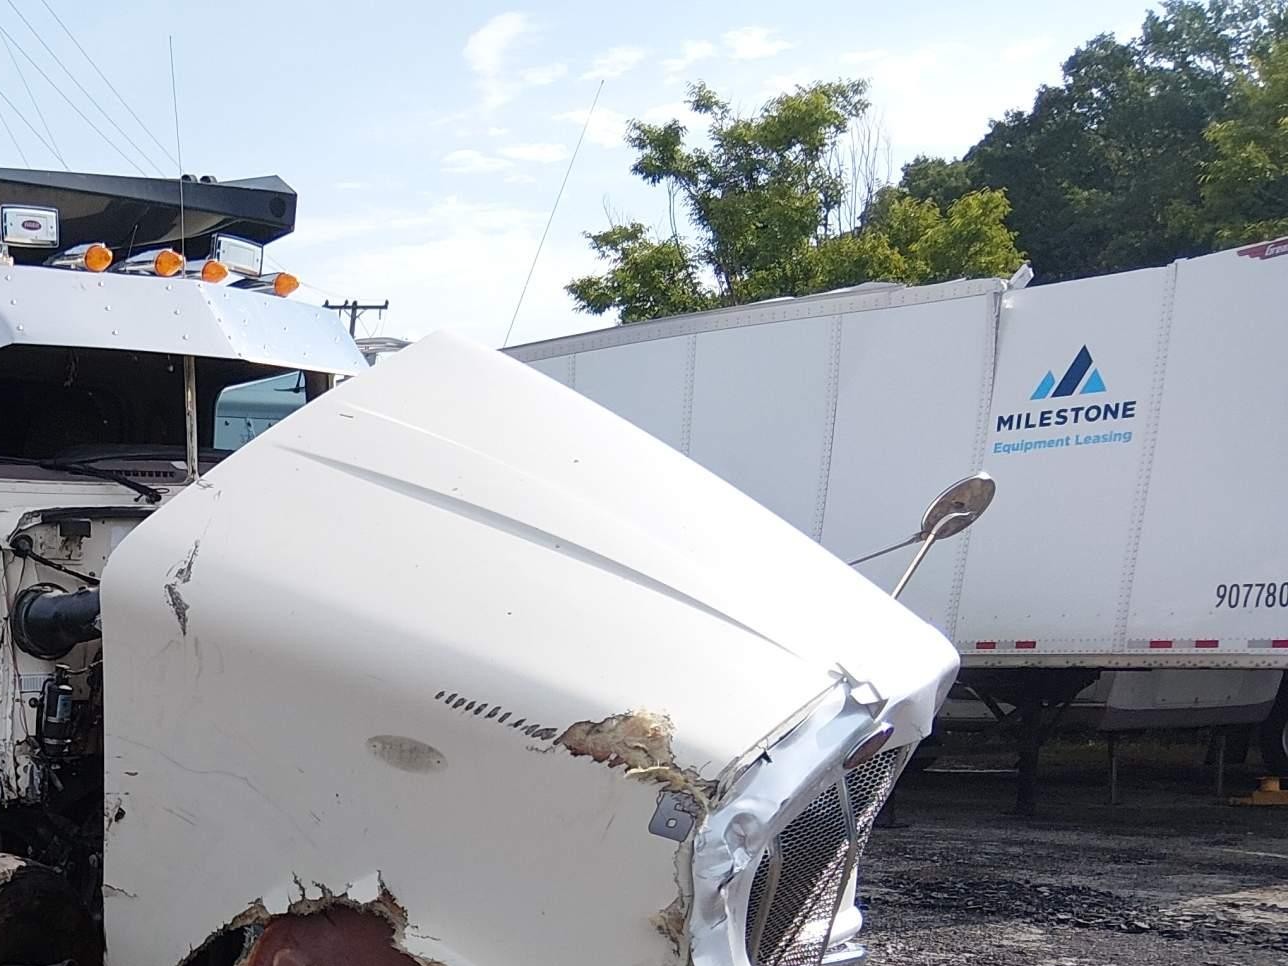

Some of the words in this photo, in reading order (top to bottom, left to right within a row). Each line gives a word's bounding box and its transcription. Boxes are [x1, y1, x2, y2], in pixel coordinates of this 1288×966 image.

[996, 400, 1137, 432] MILESTONE
[993, 435, 1071, 454] Equipment
[1075, 430, 1133, 446] Leasing
[1215, 582, 1288, 609] 907780
